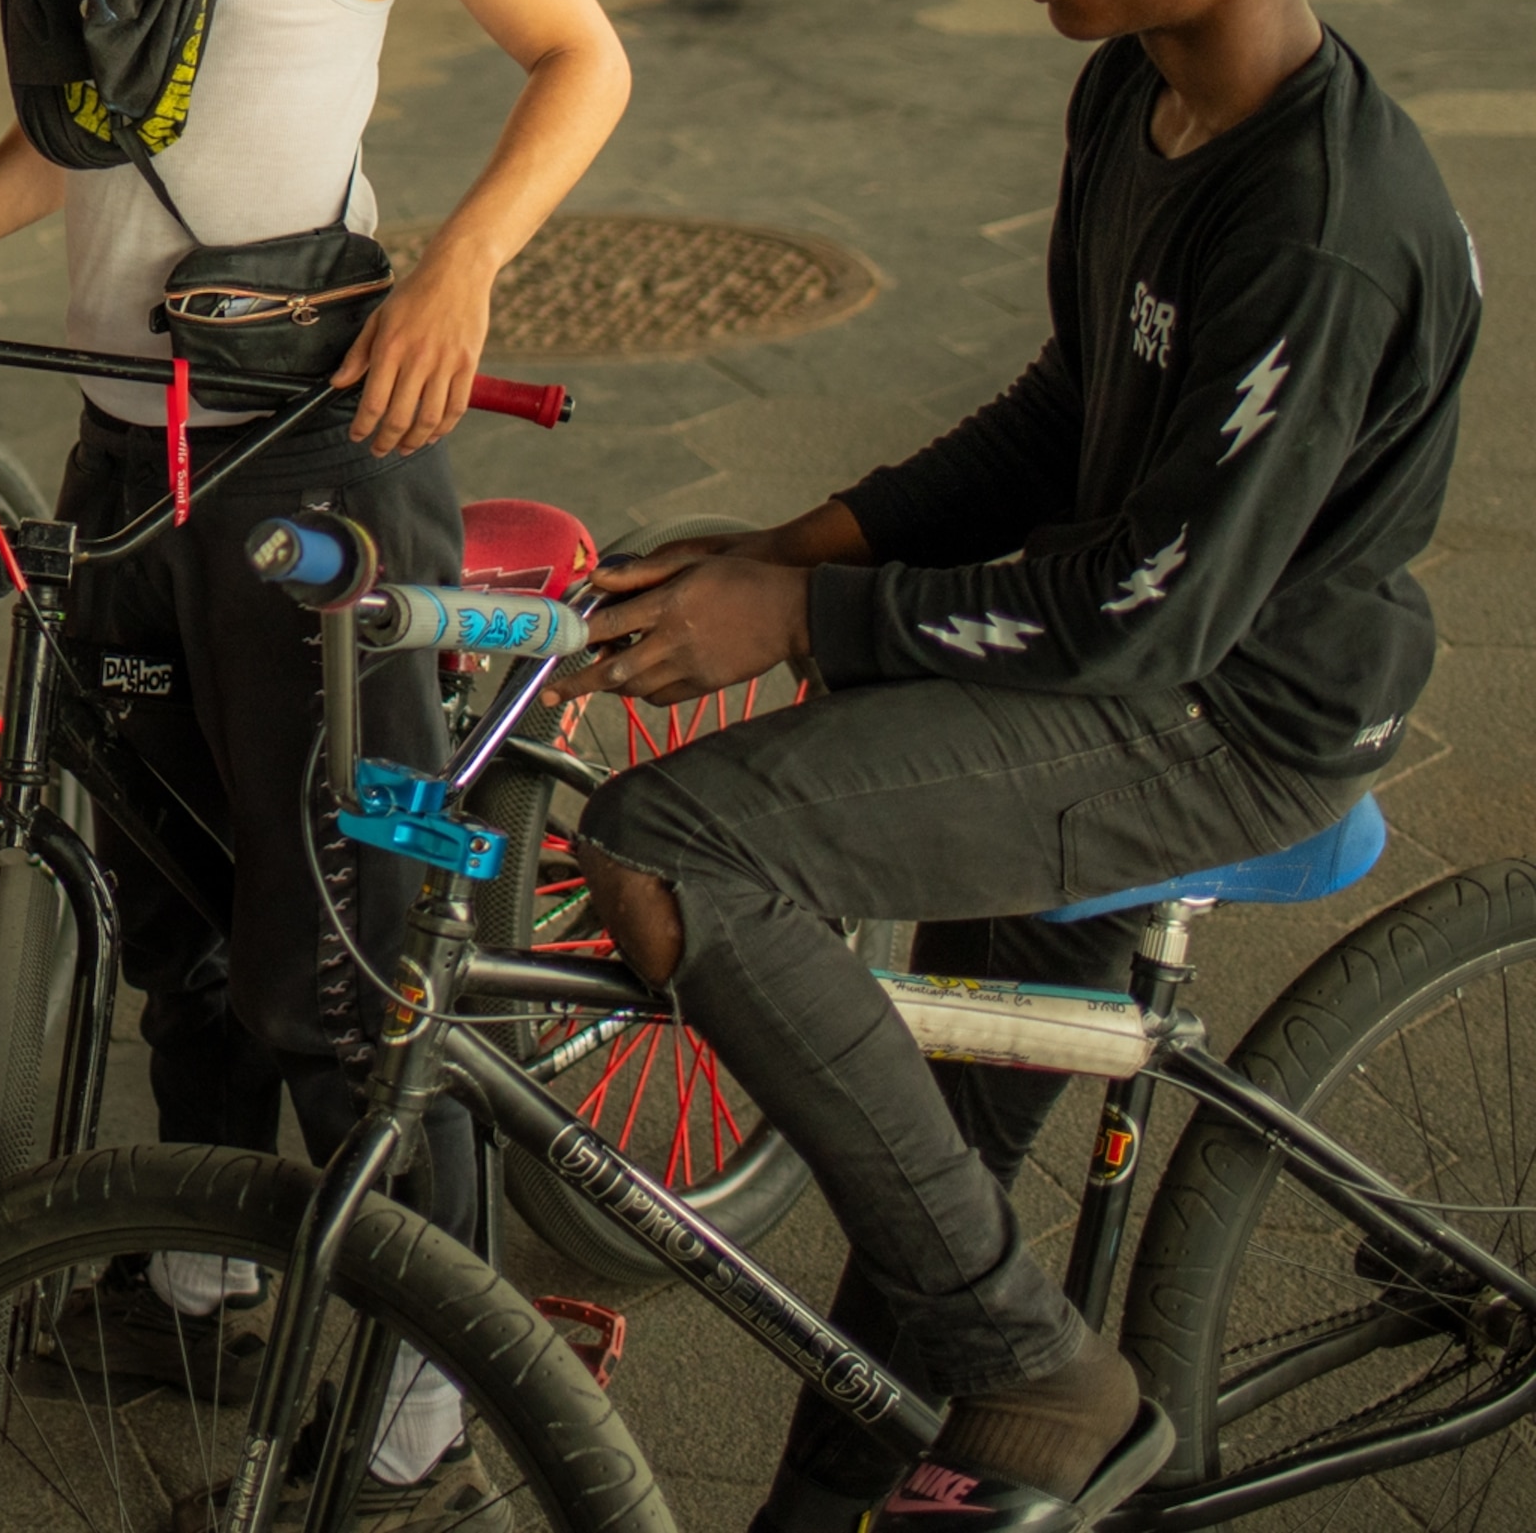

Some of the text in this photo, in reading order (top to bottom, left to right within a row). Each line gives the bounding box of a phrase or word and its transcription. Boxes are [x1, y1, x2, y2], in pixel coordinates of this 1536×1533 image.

[1132, 328, 1171, 368] NYC
[892, 977, 963, 1000] Huntington
[548, 1123, 901, 1423] GT PRO SERIES GT
[903, 1462, 981, 1504] NIKE
